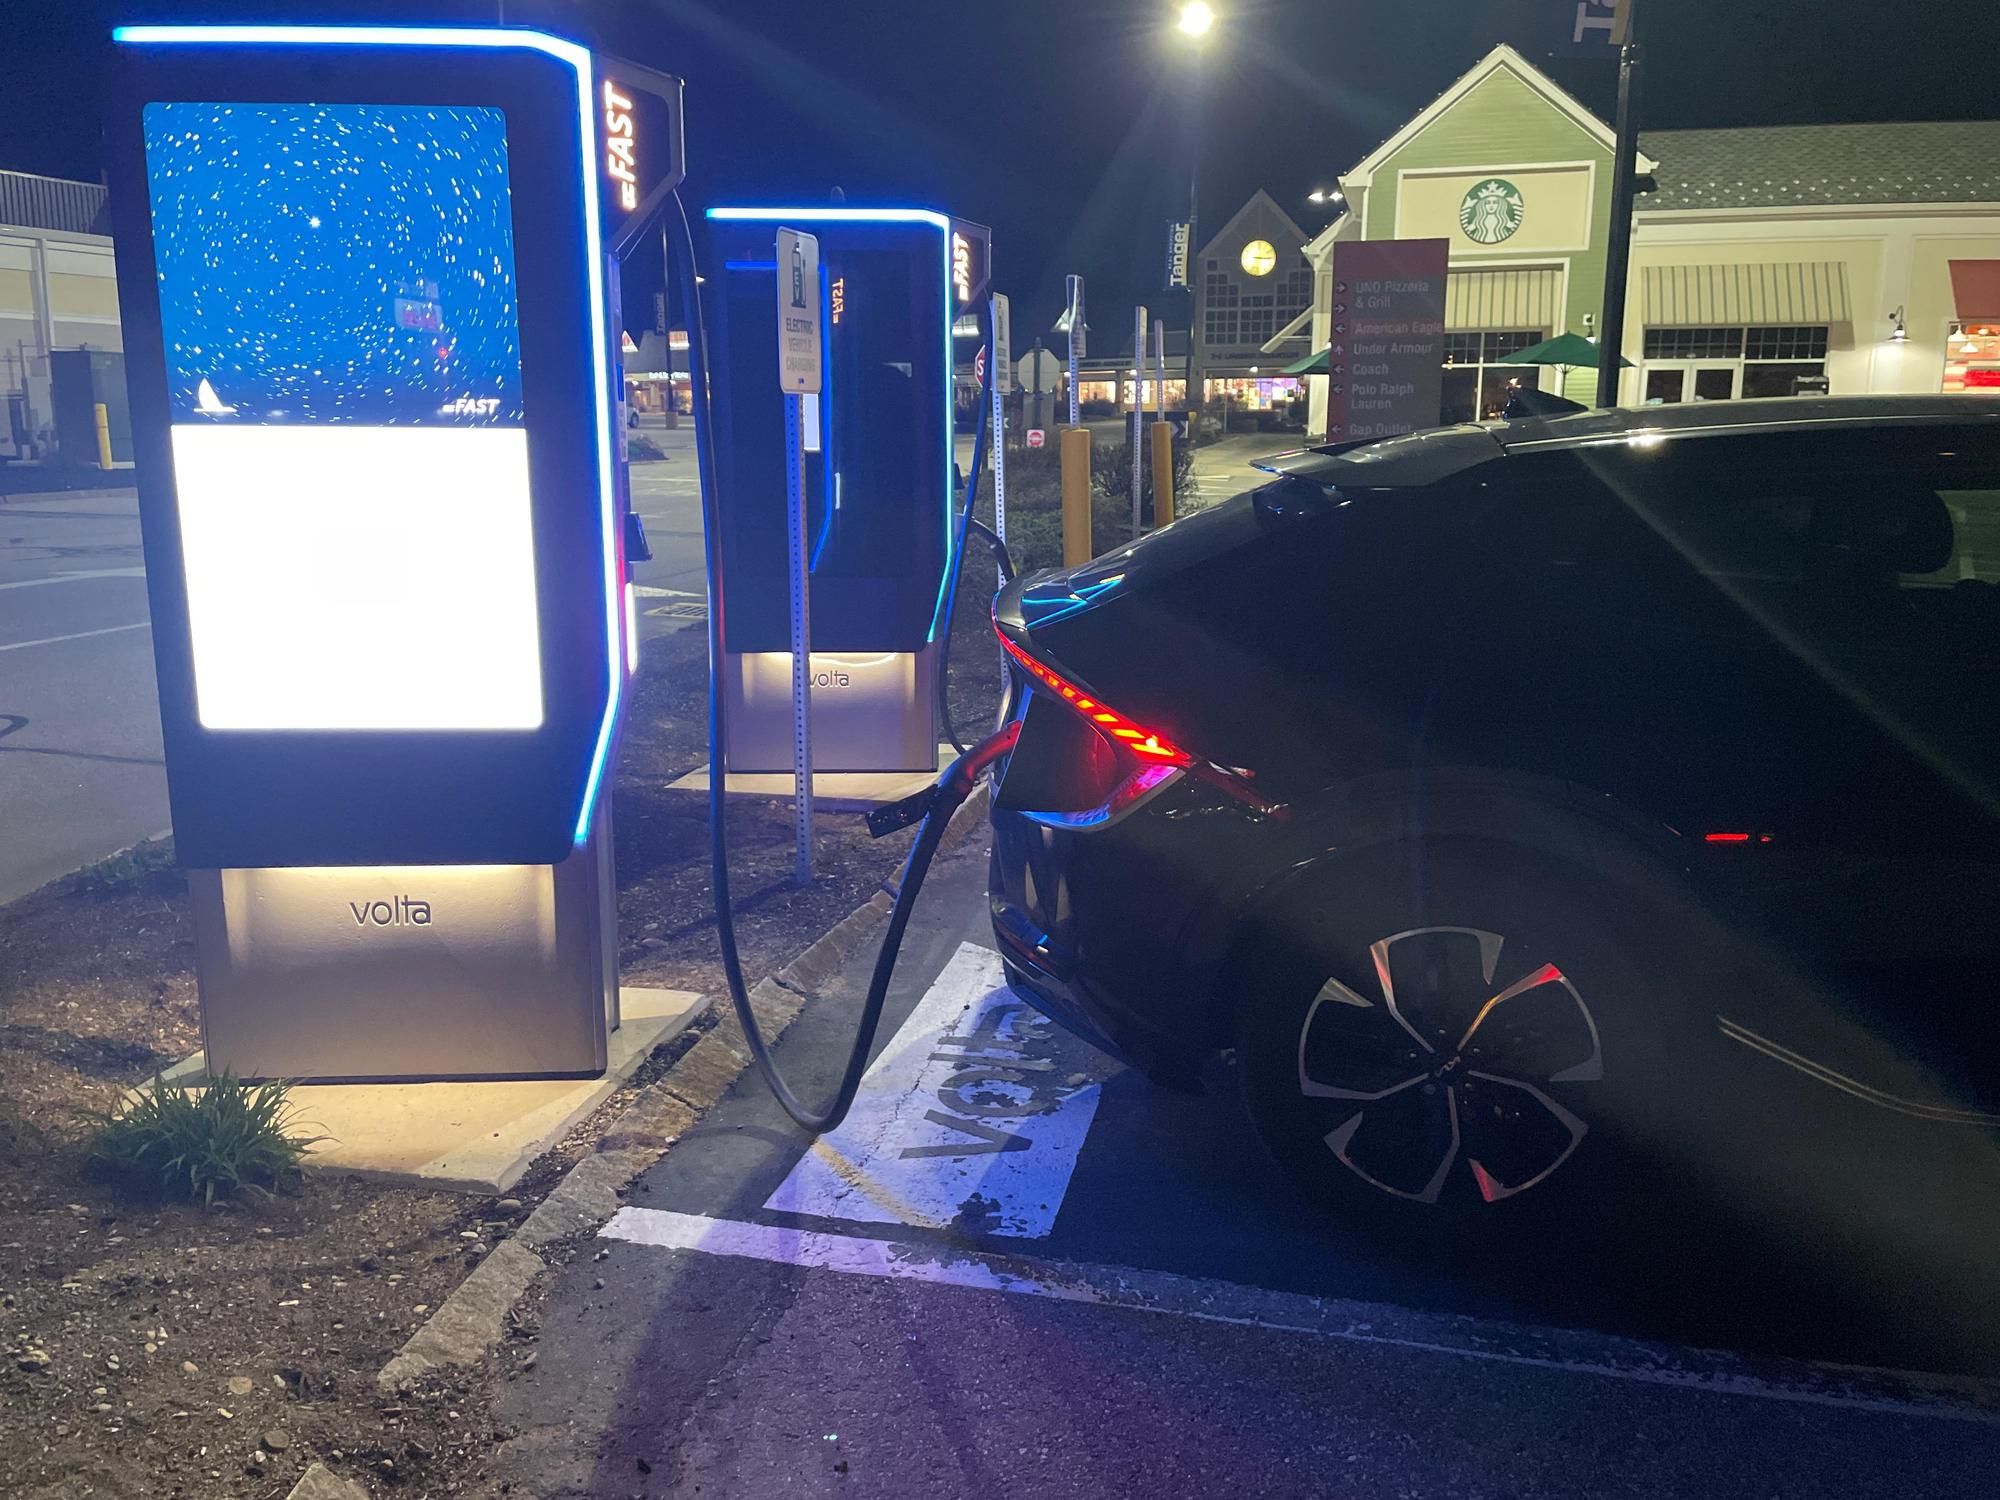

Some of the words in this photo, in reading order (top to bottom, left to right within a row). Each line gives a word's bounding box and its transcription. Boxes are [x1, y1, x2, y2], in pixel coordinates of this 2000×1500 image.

[1170, 223, 1186, 287] Tanger
[1355, 281, 1381, 294] UNO
[1384, 280, 1429, 293] Pizzeria
[1355, 297, 1362, 308] &
[1367, 296, 1391, 308] Grill
[785, 316, 814, 334] ELECTRIC
[1354, 322, 1408, 335] American
[1412, 320, 1443, 336] Eagle
[1353, 343, 1386, 355] Under
[1390, 342, 1434, 354] Armour
[1352, 363, 1389, 375] Coach
[1351, 383, 1377, 395] Polo
[1380, 382, 1414, 396] Ralph
[1351, 399, 1392, 410] Lauren
[1349, 424, 1373, 437] Gap
[1376, 422, 1412, 436] Outlet
[809, 669, 850, 687] volta
[349, 894, 431, 925] volta
